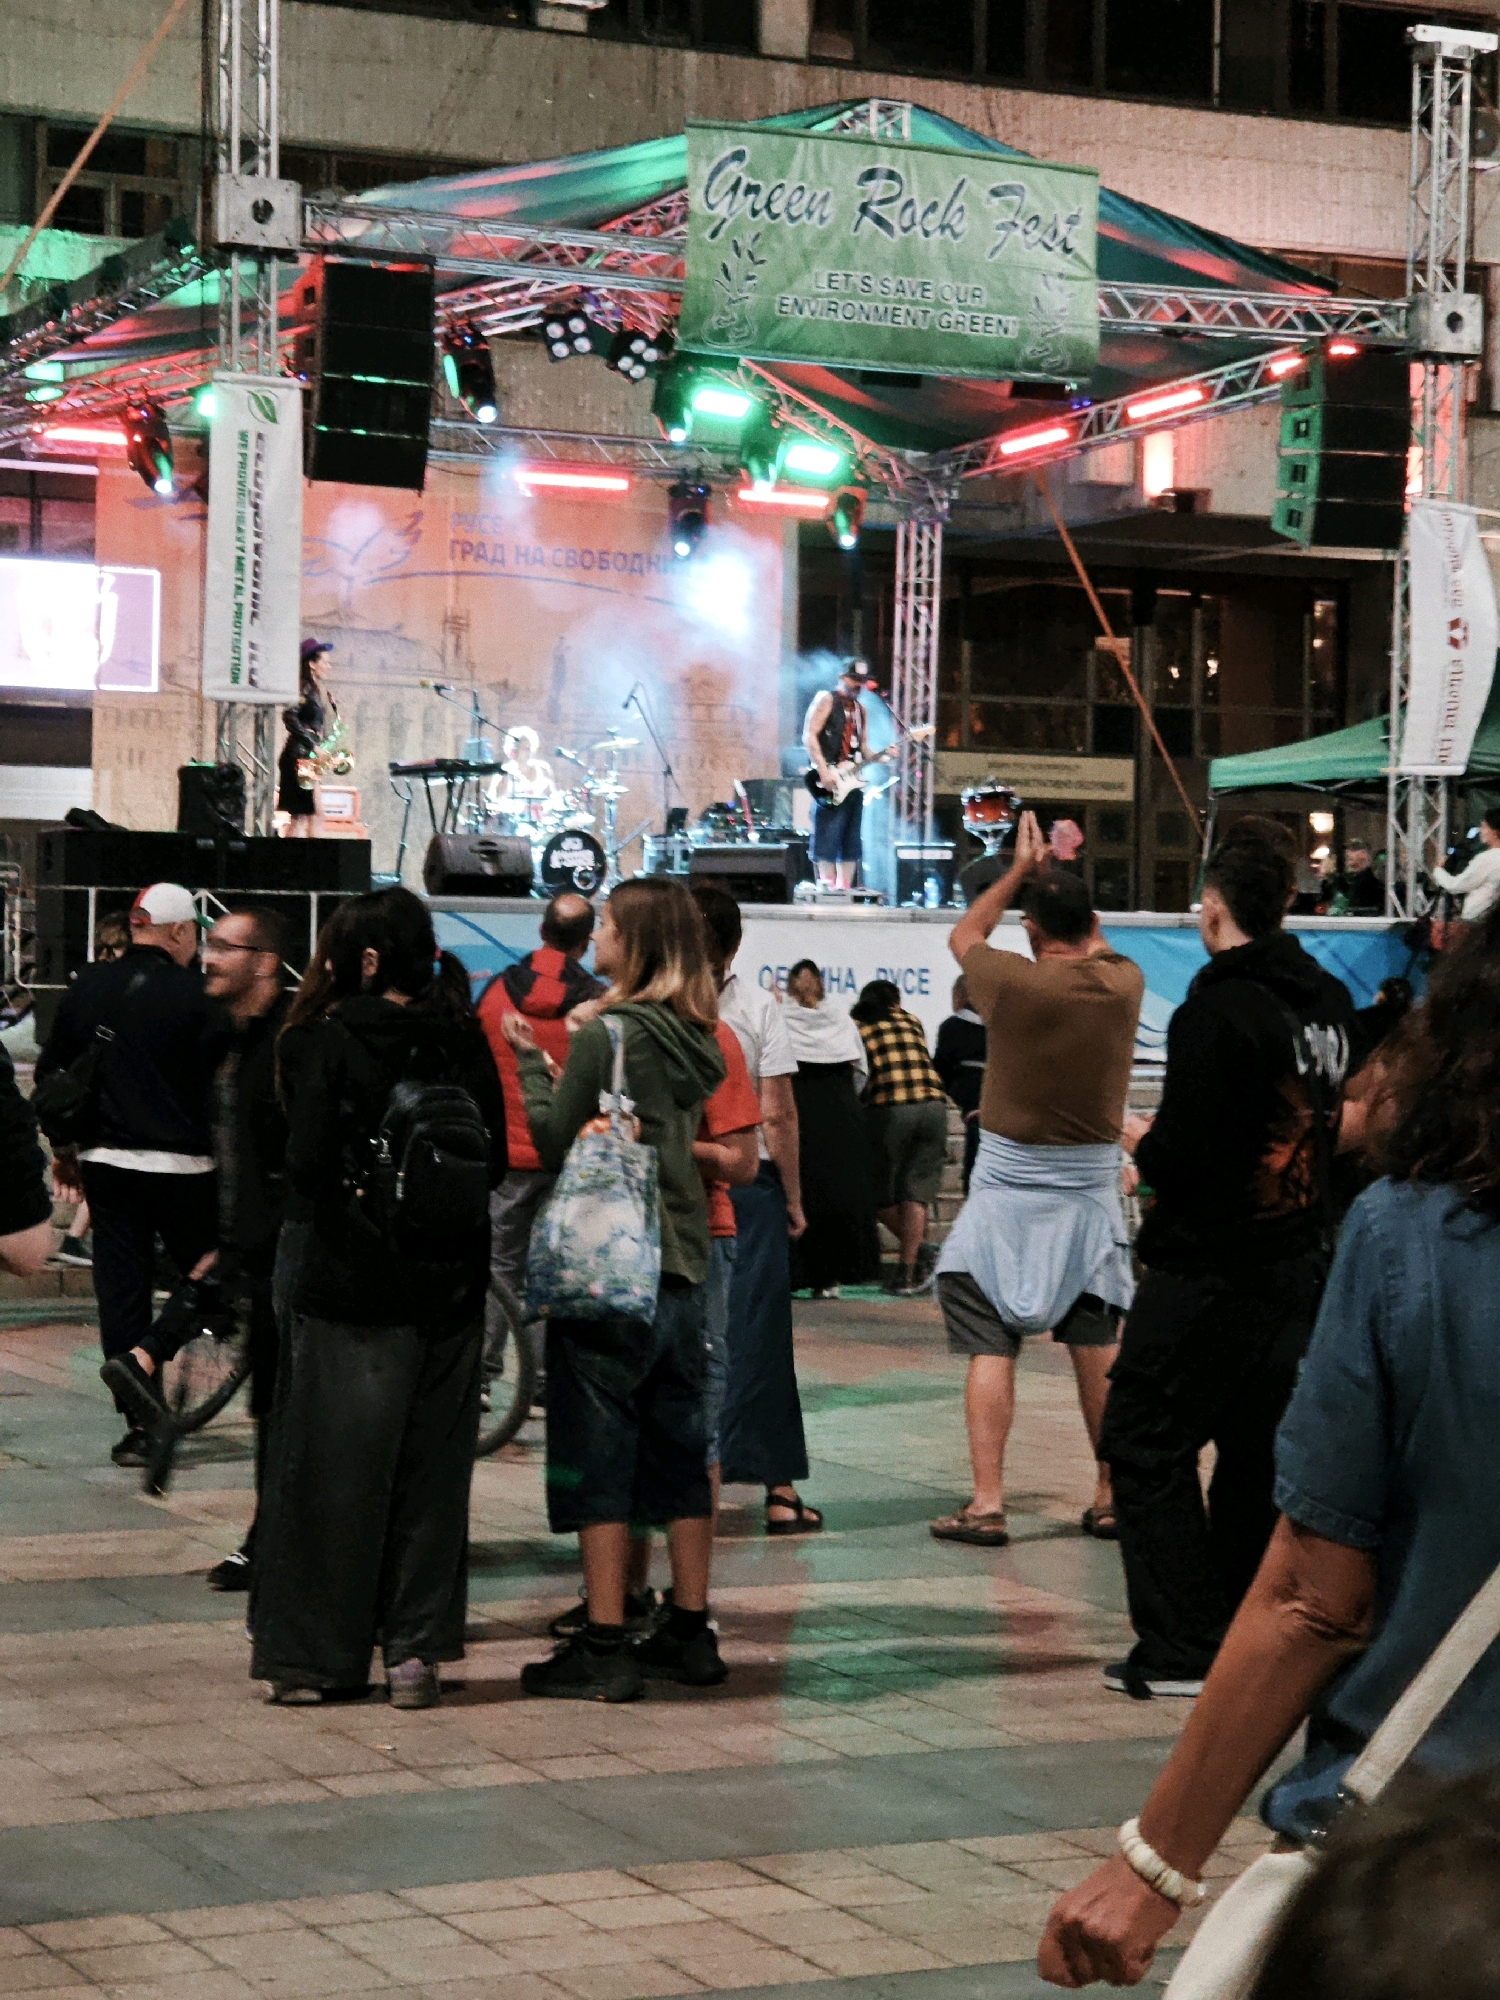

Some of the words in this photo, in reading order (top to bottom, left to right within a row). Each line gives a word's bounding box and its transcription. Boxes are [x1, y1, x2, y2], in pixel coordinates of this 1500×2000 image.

[704, 148, 832, 240] Green
[853, 166, 968, 240] Rock
[987, 183, 1082, 260] Fest
[814, 271, 873, 294] LET'S
[879, 275, 933, 300] SAVE
[940, 283, 985, 304] OUR
[778, 296, 931, 329] ENVIRONMENT
[237, 430, 249, 450] WE
[236, 451, 248, 508] PROVIDE
[235, 510, 246, 554] HEAVY
[451, 513, 503, 535] РУСЕ
[450, 540, 506, 567] ГРАД
[514, 545, 546, 566] НА
[551, 547, 672, 576] СВОБОДН
[233, 555, 245, 599] METAL
[230, 602, 243, 685] PROTECTION
[758, 965, 858, 994] ОБНА
